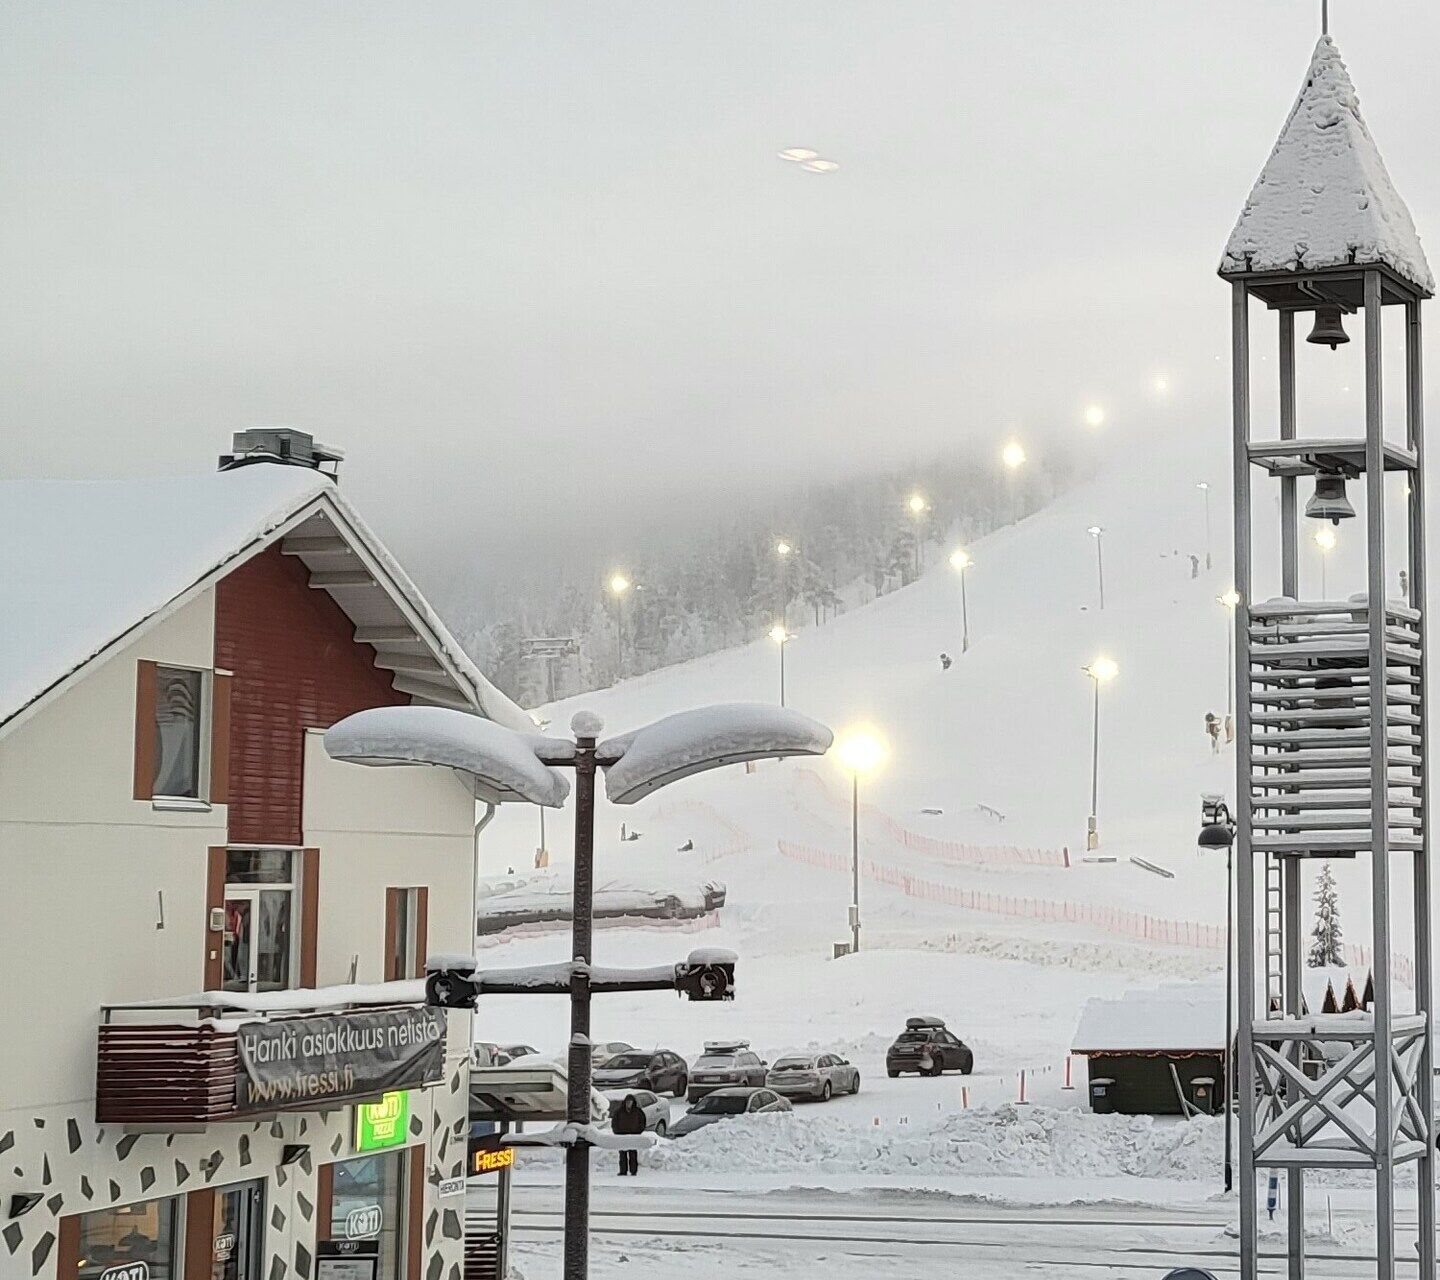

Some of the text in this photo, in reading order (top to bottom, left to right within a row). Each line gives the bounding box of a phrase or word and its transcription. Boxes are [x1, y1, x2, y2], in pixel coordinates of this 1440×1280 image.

[245, 1015, 441, 1064] Hanki asiakkuus netistä
[248, 1064, 355, 1103] www.fressi.fi
[475, 1148, 514, 1172] FRESSI
[350, 1209, 378, 1235] KOTI
